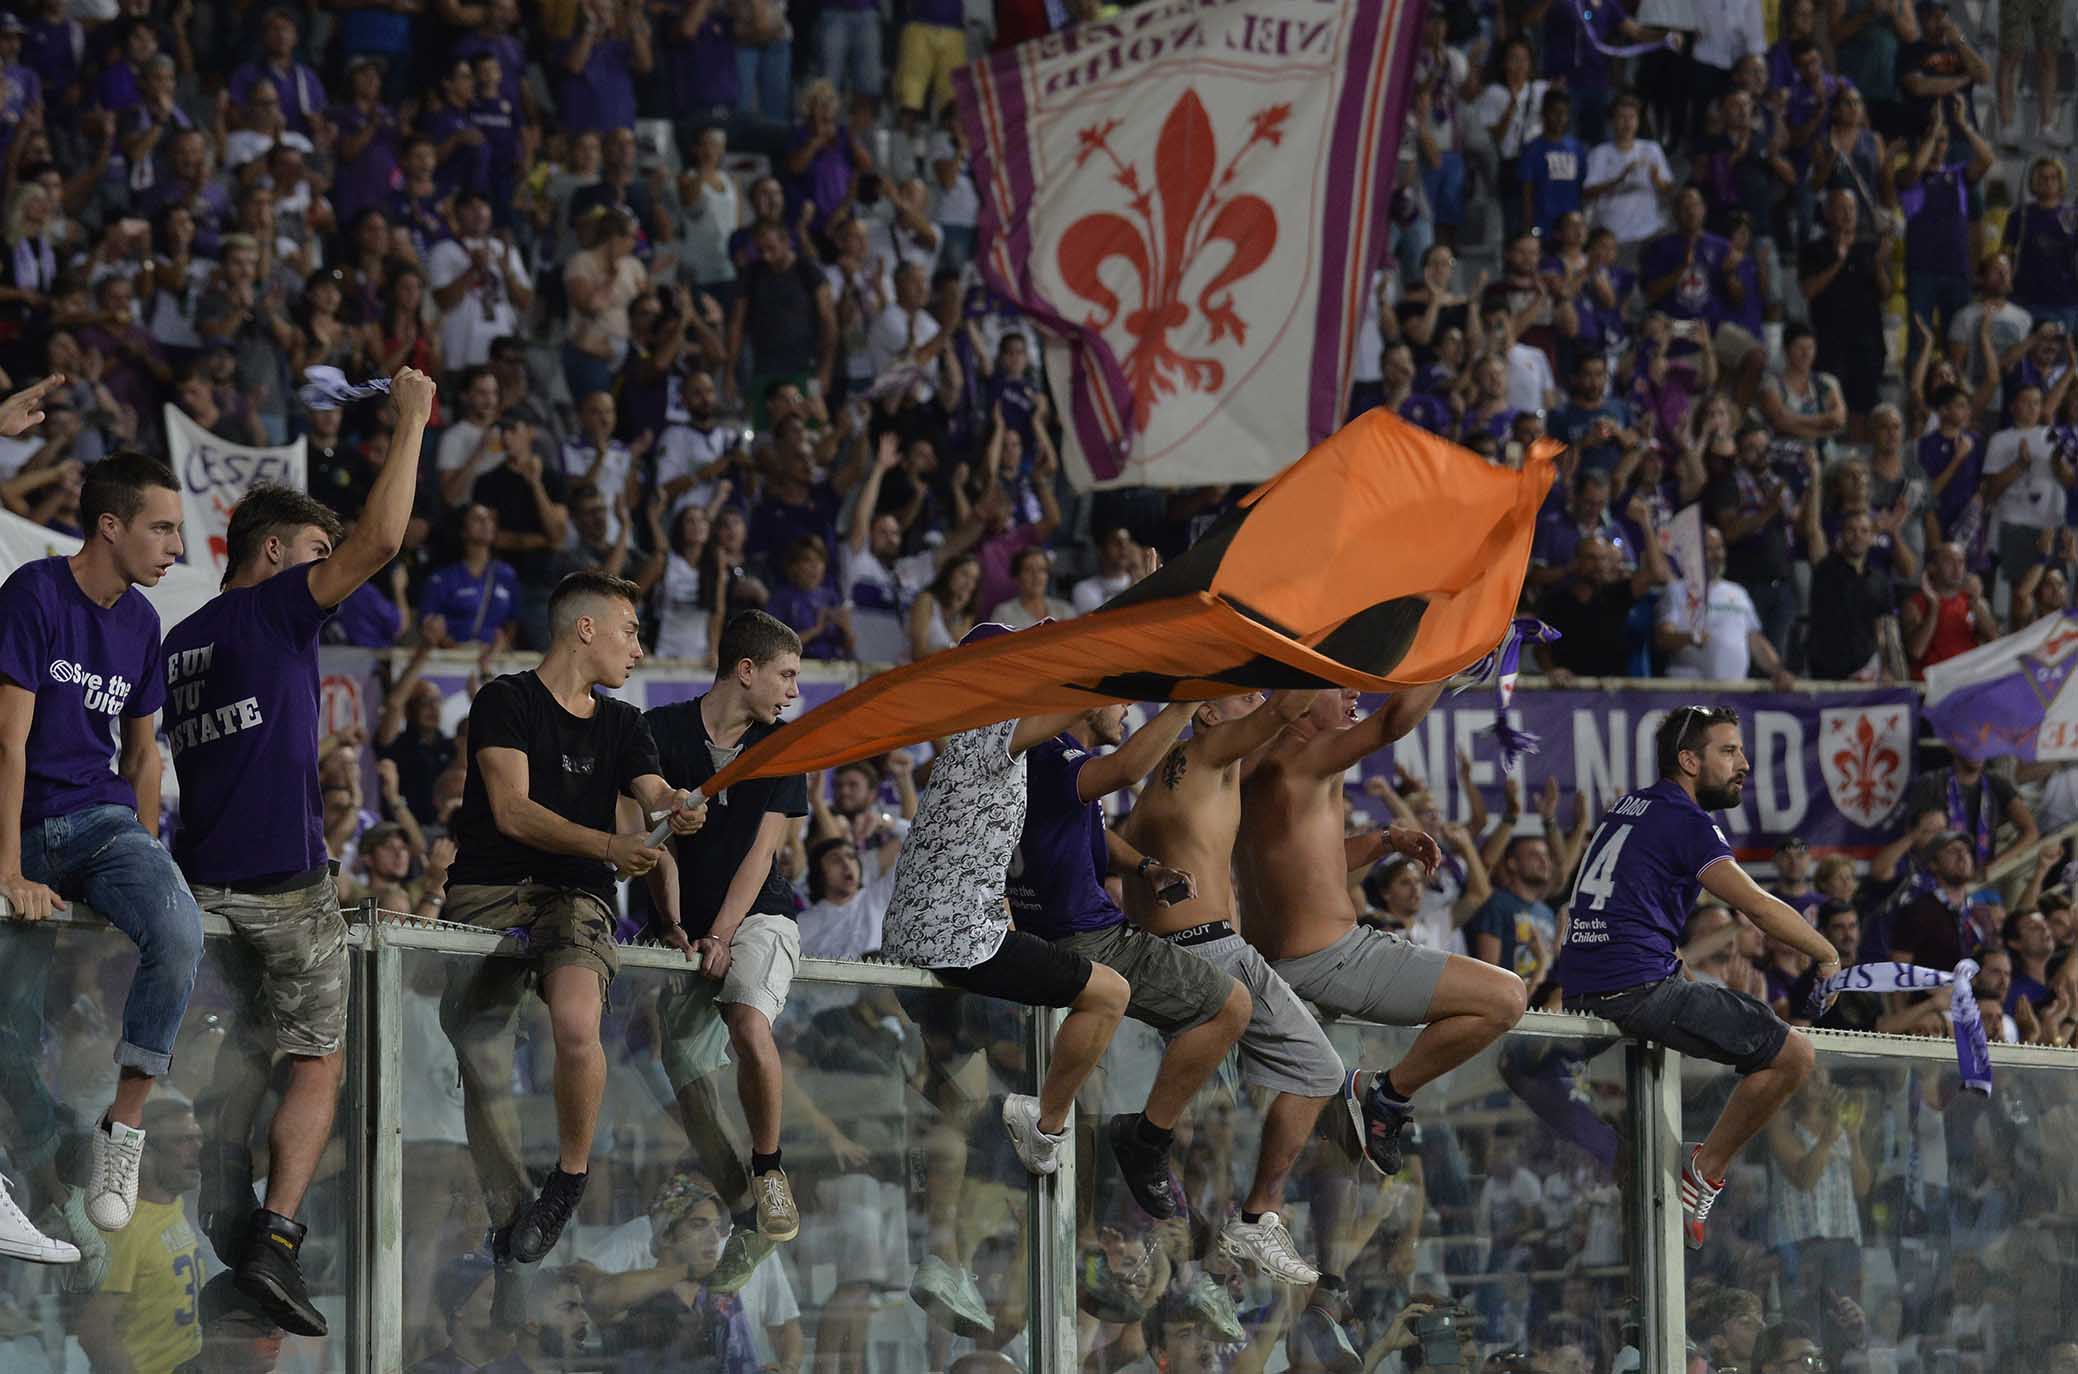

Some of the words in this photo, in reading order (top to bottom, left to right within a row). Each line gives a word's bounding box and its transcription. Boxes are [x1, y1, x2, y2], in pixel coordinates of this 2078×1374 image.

[169, 695, 264, 759] STATE
[1572, 708, 1809, 834] ND
[1568, 821, 1634, 910] 14
[1571, 932, 1610, 943] Children
